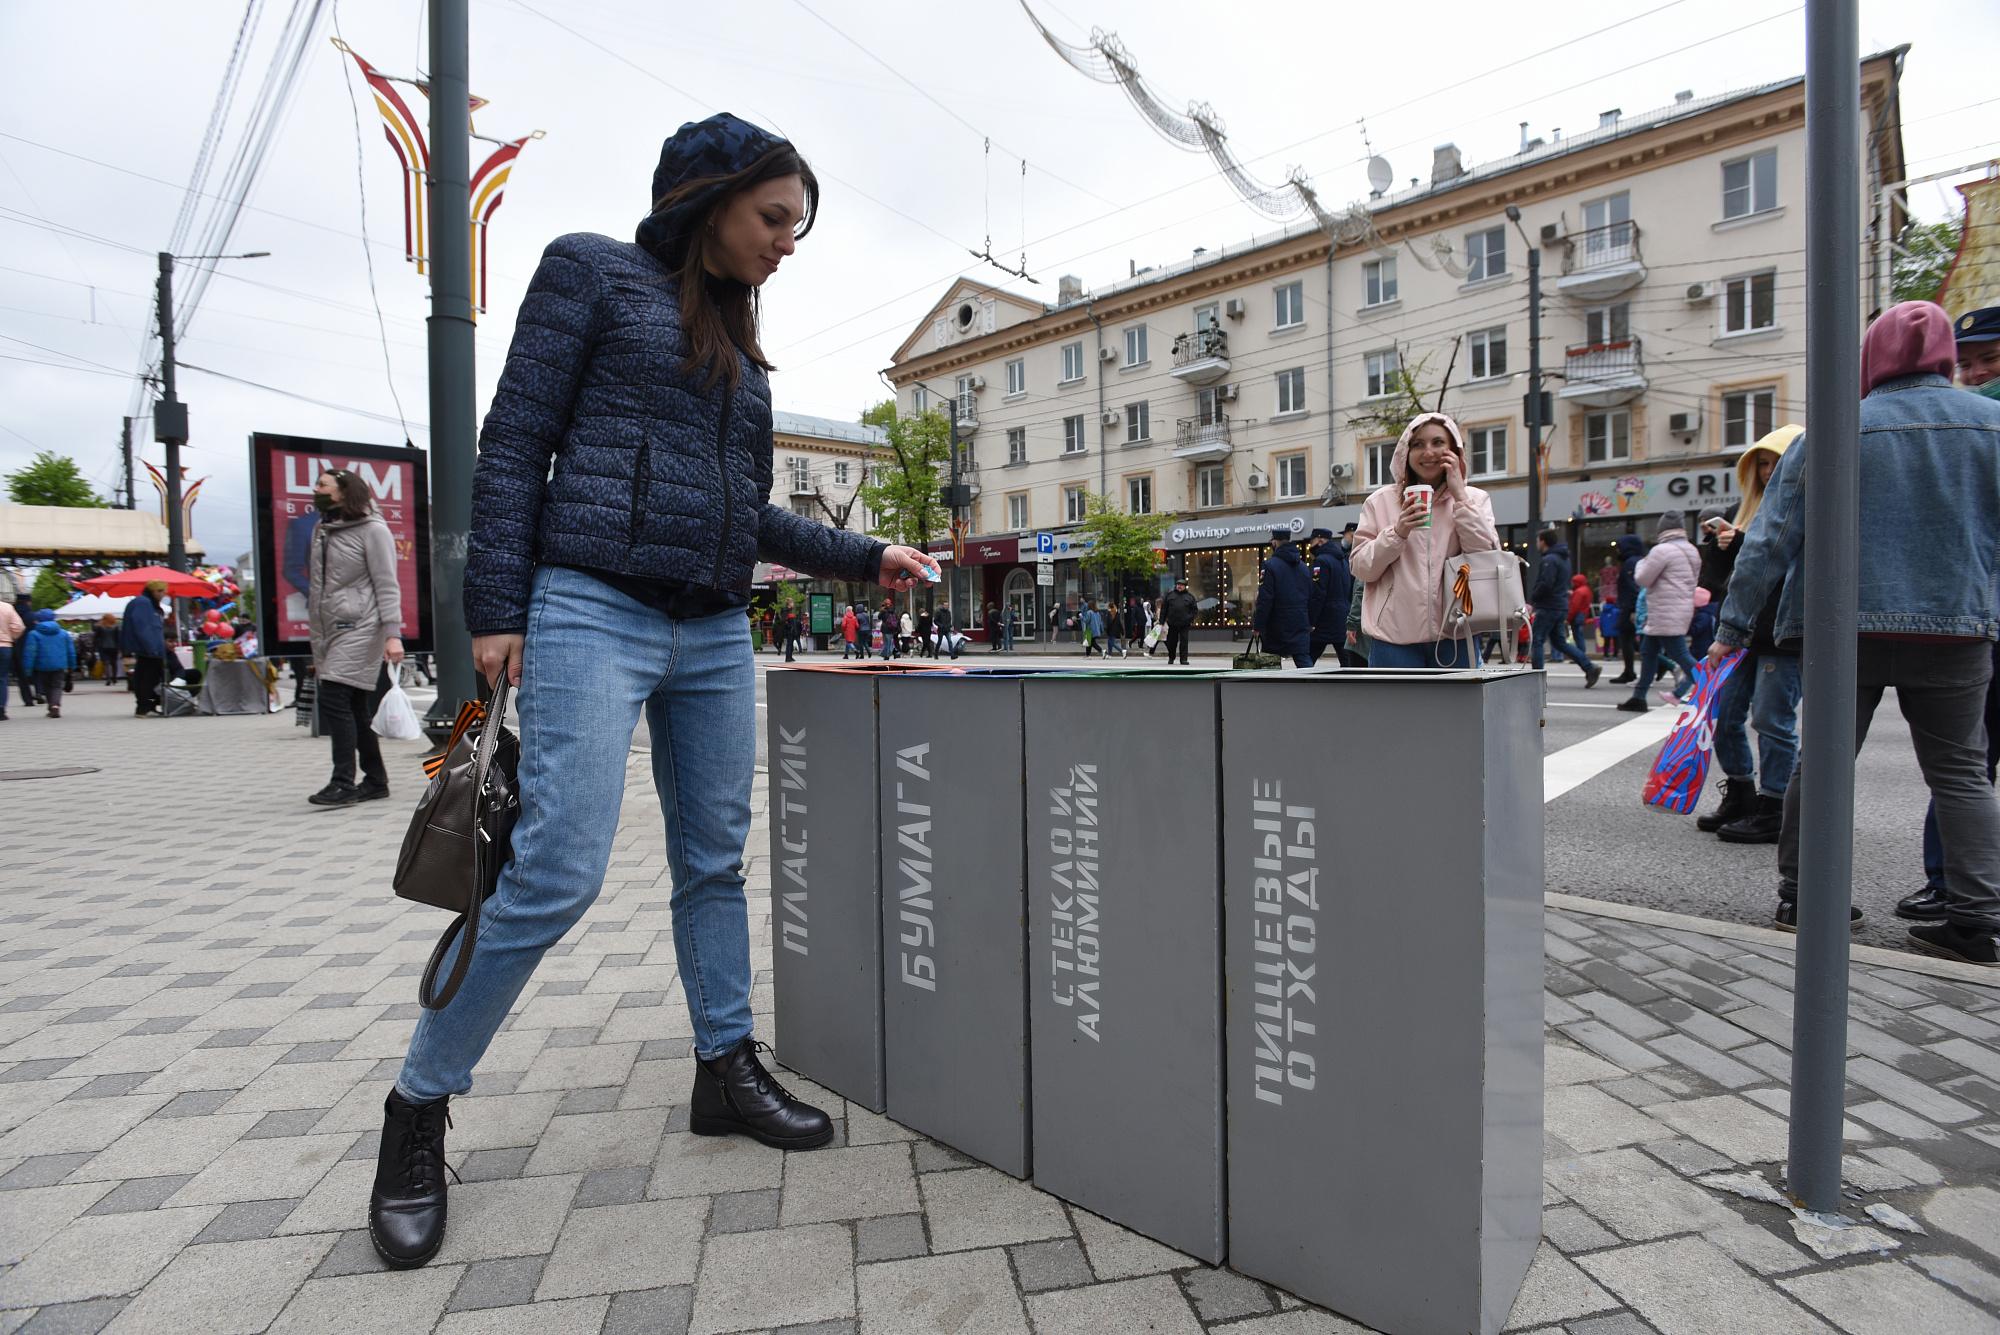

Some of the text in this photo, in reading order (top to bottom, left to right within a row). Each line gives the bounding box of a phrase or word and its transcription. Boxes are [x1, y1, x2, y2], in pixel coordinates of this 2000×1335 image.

[1041, 535, 1050, 552] P
[1185, 526, 1230, 540] flowingo
[1668, 472, 1731, 497] GRI
[779, 725, 809, 956] ПЛАСТИК
[895, 741, 937, 992] БУМАГА
[1049, 787, 1074, 1007] СТЕКЛО И
[1069, 763, 1100, 1043] АЛЮМИНИЙ
[1253, 778, 1284, 1106] ПИЩЕВЫЕ
[1286, 806, 1320, 1091] ОТХОДЫ
